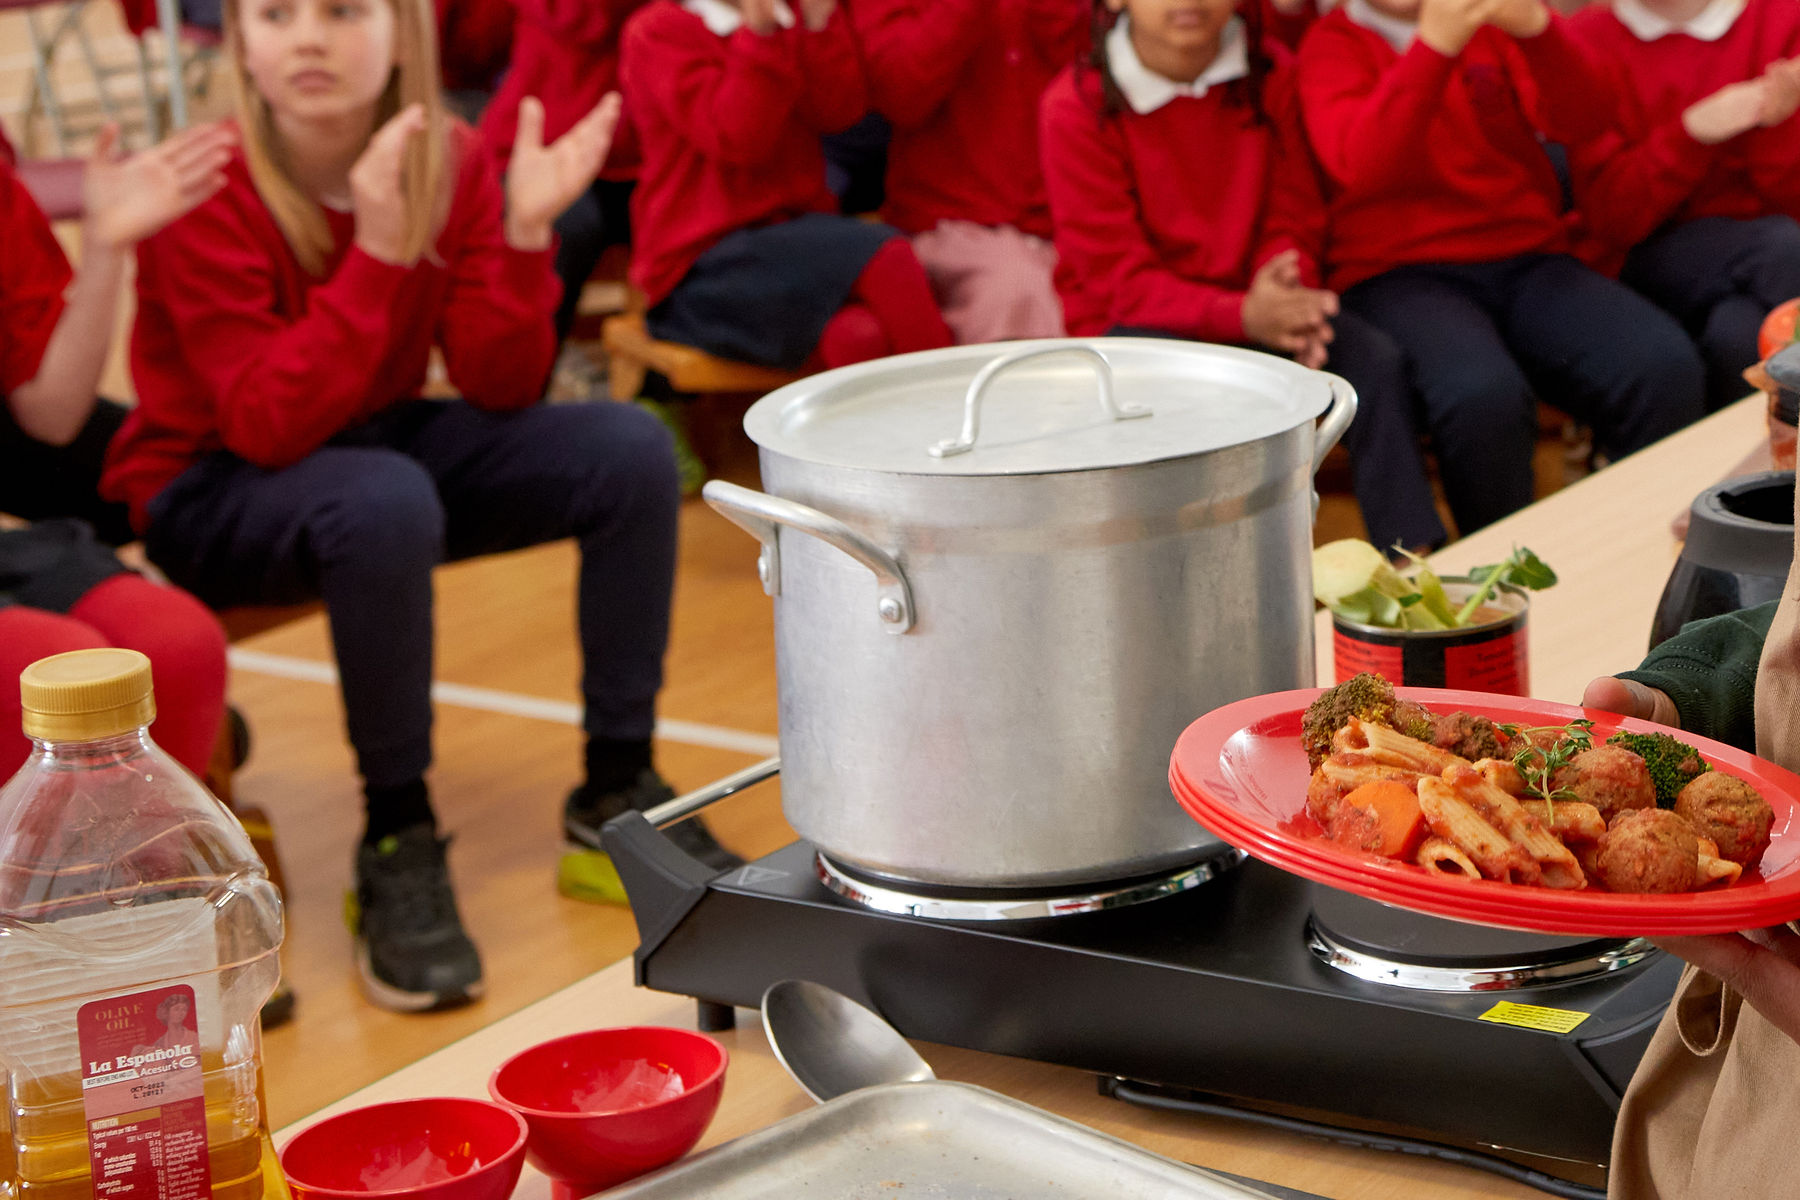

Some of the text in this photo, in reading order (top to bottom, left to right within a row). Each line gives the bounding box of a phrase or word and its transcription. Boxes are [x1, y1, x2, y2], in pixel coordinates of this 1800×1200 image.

[95, 1003, 144, 1022] OLIVE
[106, 1018, 135, 1032] OIL
[89, 1044, 193, 1075] La Española
[140, 1064, 171, 1077] Acesur
